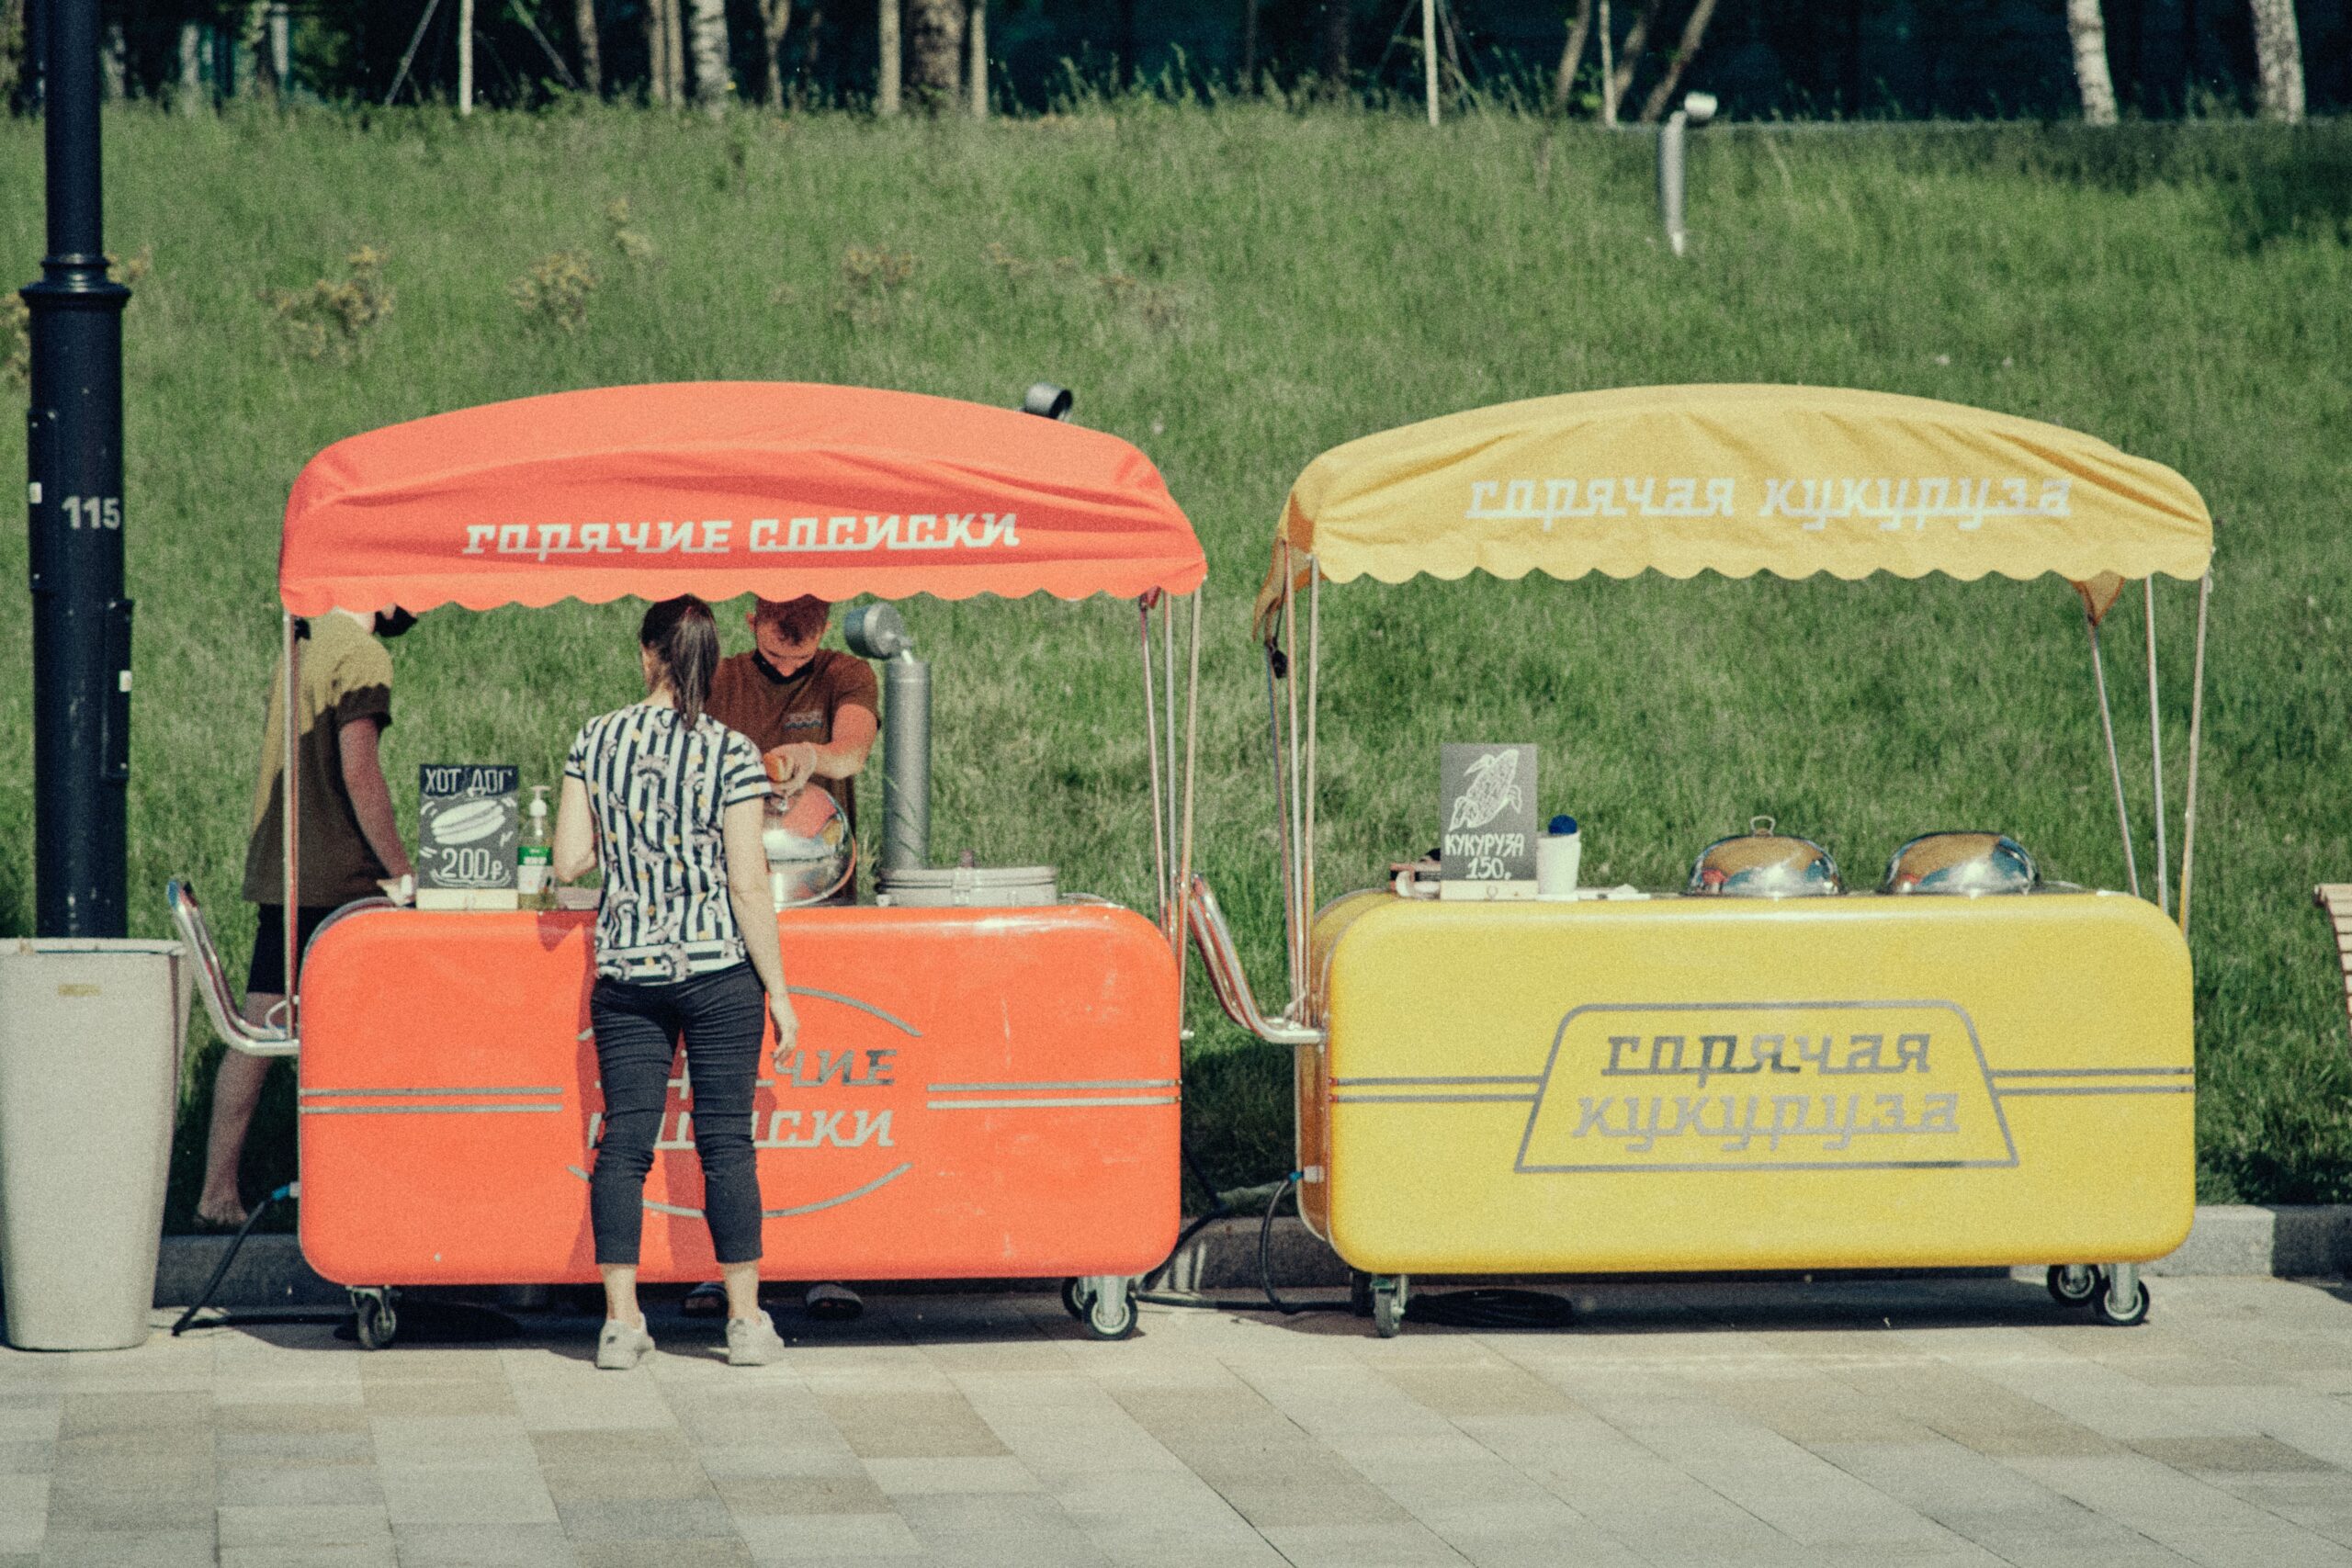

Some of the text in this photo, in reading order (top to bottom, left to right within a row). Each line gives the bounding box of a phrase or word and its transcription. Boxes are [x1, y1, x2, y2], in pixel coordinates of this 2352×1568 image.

[61, 496, 121, 530] 115
[1465, 477, 2072, 530] горячая кукуруза
[425, 768, 513, 797] ХОТ ДОГ
[1444, 833, 1524, 857] КУКУРУЗА
[1601, 1032, 1929, 1088] горячая
[1572, 1093, 1959, 1151] кукуруза
